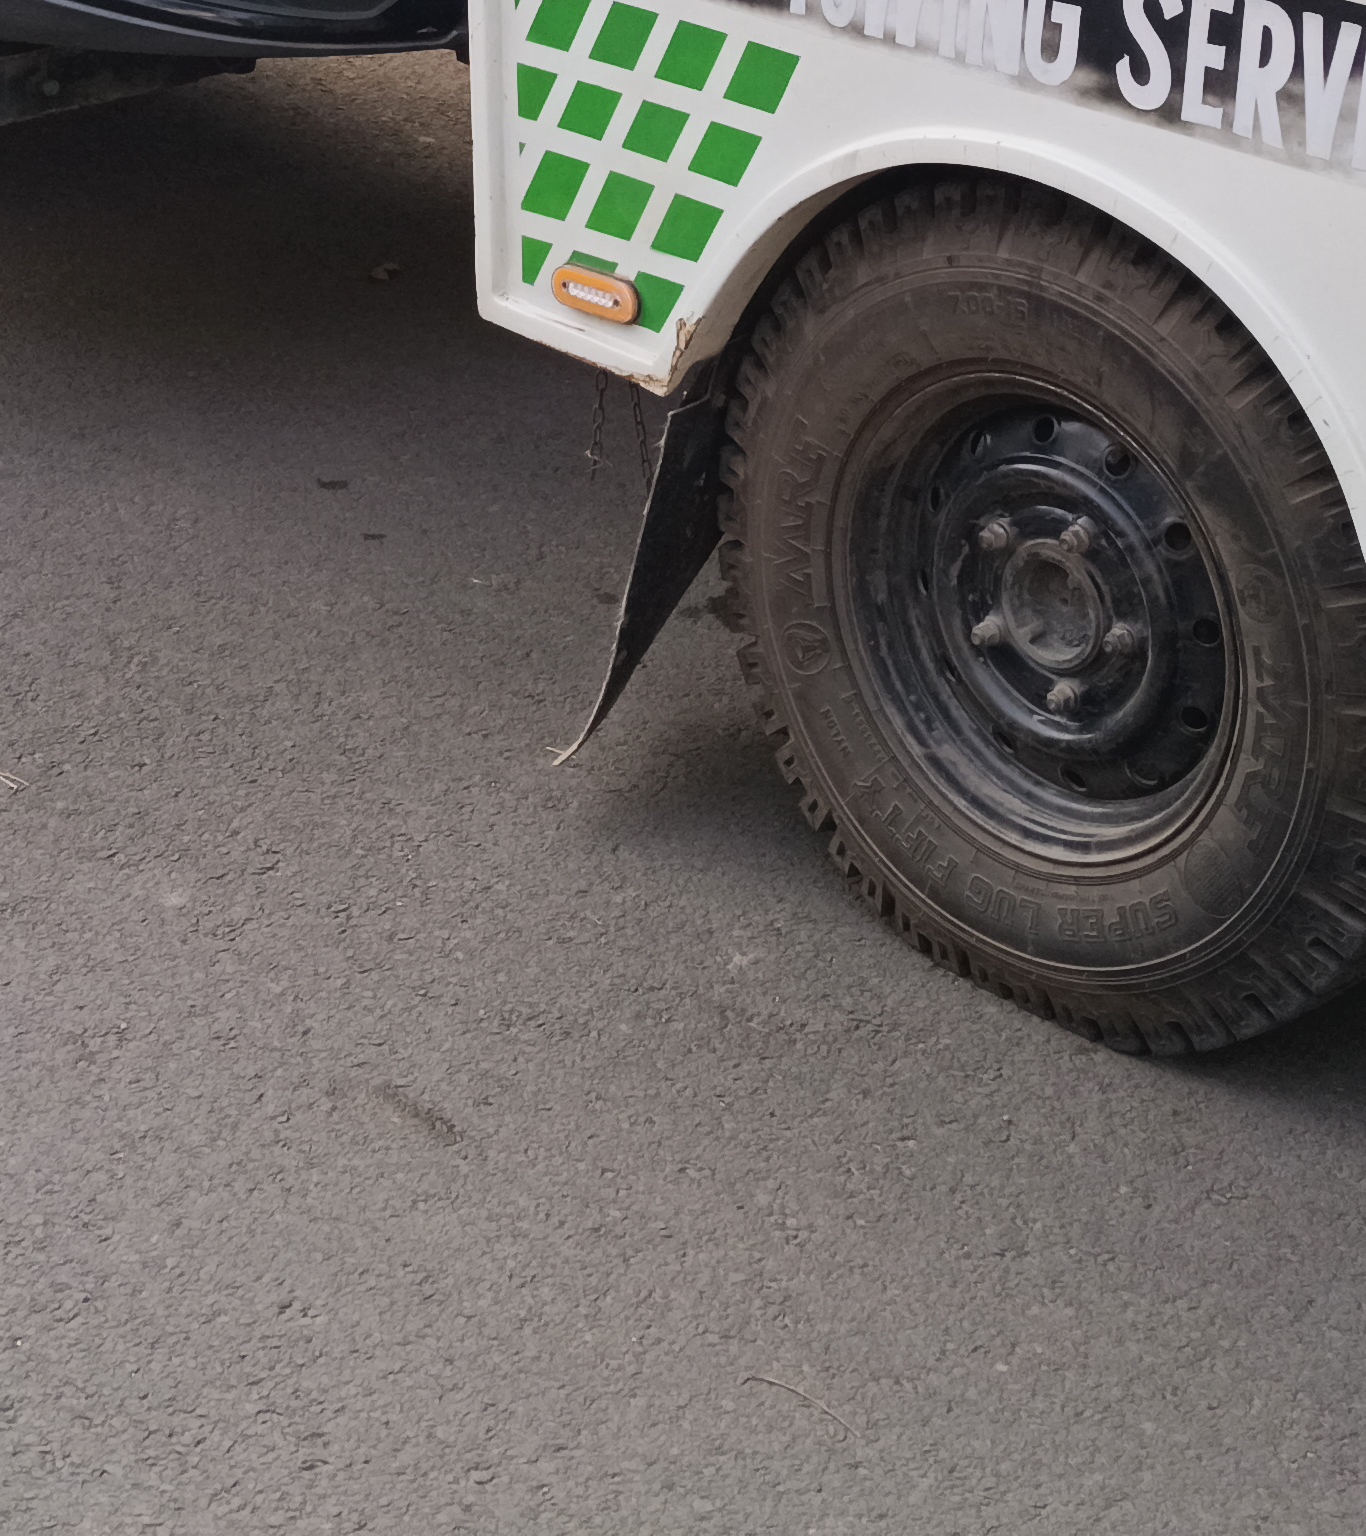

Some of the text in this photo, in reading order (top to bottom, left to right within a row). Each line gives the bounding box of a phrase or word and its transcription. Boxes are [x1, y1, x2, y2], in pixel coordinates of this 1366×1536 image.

[850, 775, 959, 887] FIFTY
[964, 874, 1042, 936] LUG
[1055, 888, 1180, 943] SUPER
